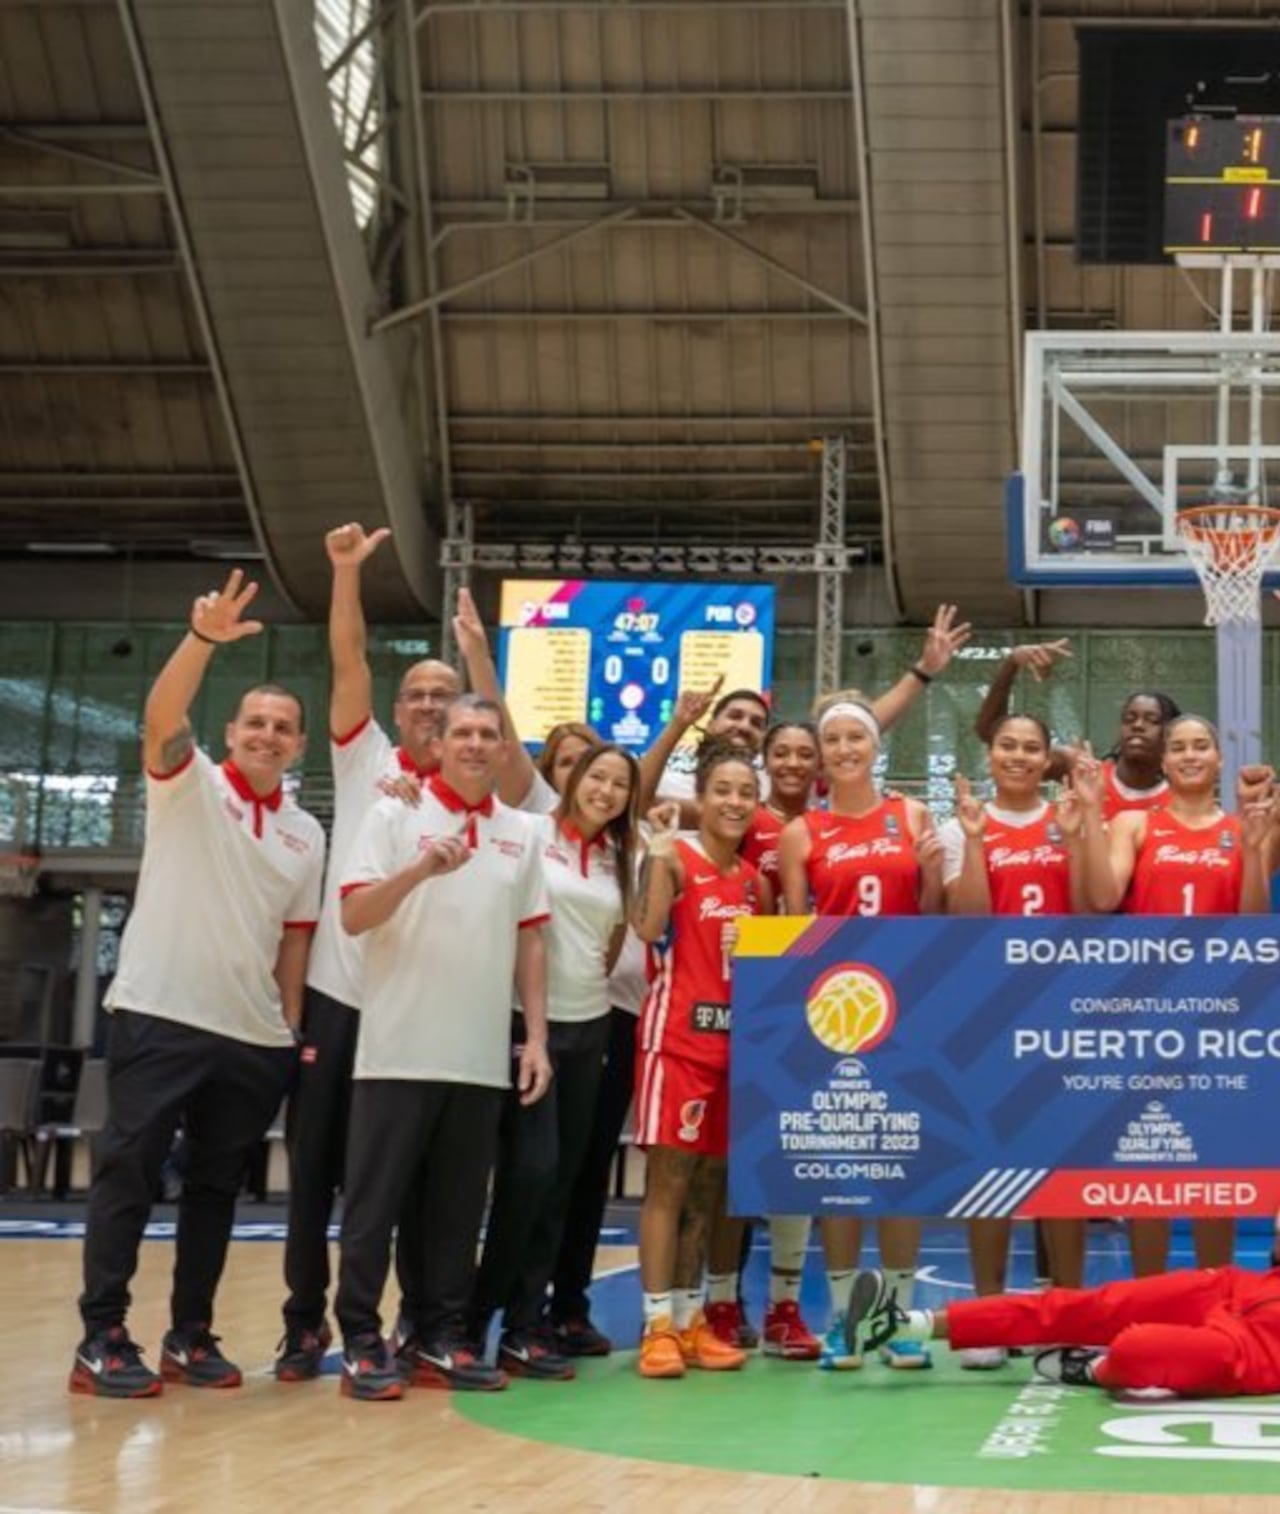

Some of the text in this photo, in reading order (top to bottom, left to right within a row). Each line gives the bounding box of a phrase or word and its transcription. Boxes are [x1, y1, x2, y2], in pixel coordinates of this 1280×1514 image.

[605, 655, 622, 684] 0
[652, 656, 669, 685] 0
[858, 875, 882, 916] 9
[1022, 884, 1044, 916] 2
[1182, 883, 1195, 916] 1
[1004, 938, 1195, 964] BOARDING
[1070, 997, 1240, 1013] CONGRATULATIONS
[1014, 1029, 1185, 1059] PUERTO
[1062, 1074, 1248, 1090] YOU'RE GOING TO THE
[812, 1091, 888, 1110] OLYMPIC
[780, 1112, 920, 1131] PRE-QUALIFYING
[1128, 1121, 1183, 1136] OLYMPIC
[781, 1134, 920, 1150] TOURNAMENT 2023
[1118, 1136, 1193, 1151] QUALIFYING
[794, 1162, 906, 1179] COLOMBIA
[1081, 1182, 1258, 1205] QUALIFIED
